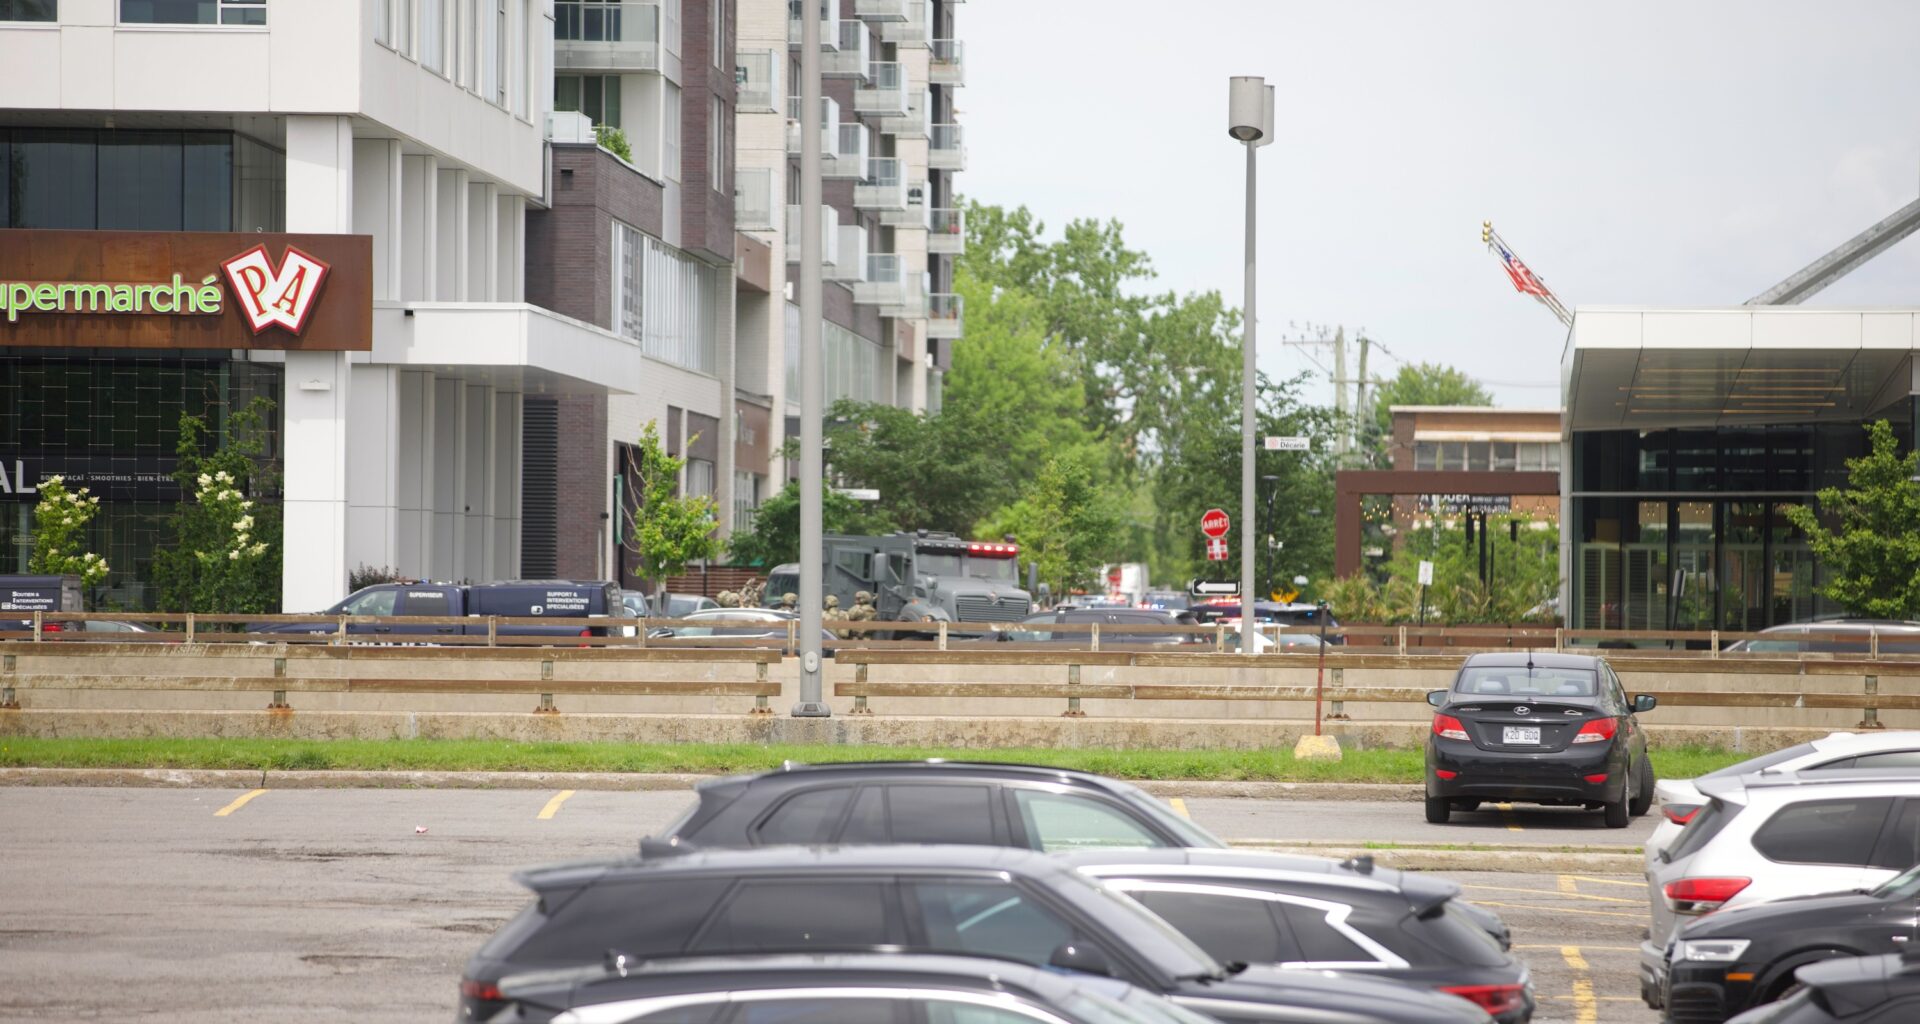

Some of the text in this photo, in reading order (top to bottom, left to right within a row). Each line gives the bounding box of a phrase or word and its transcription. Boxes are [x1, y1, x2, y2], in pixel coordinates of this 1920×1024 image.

[236, 264, 307, 317] PA
[62, 473, 84, 482] 'AÇAÏ
[90, 474, 132, 482] SMOOTHIES
[1203, 516, 1228, 529] ARRÊT
[1505, 730, 1520, 740] K20
